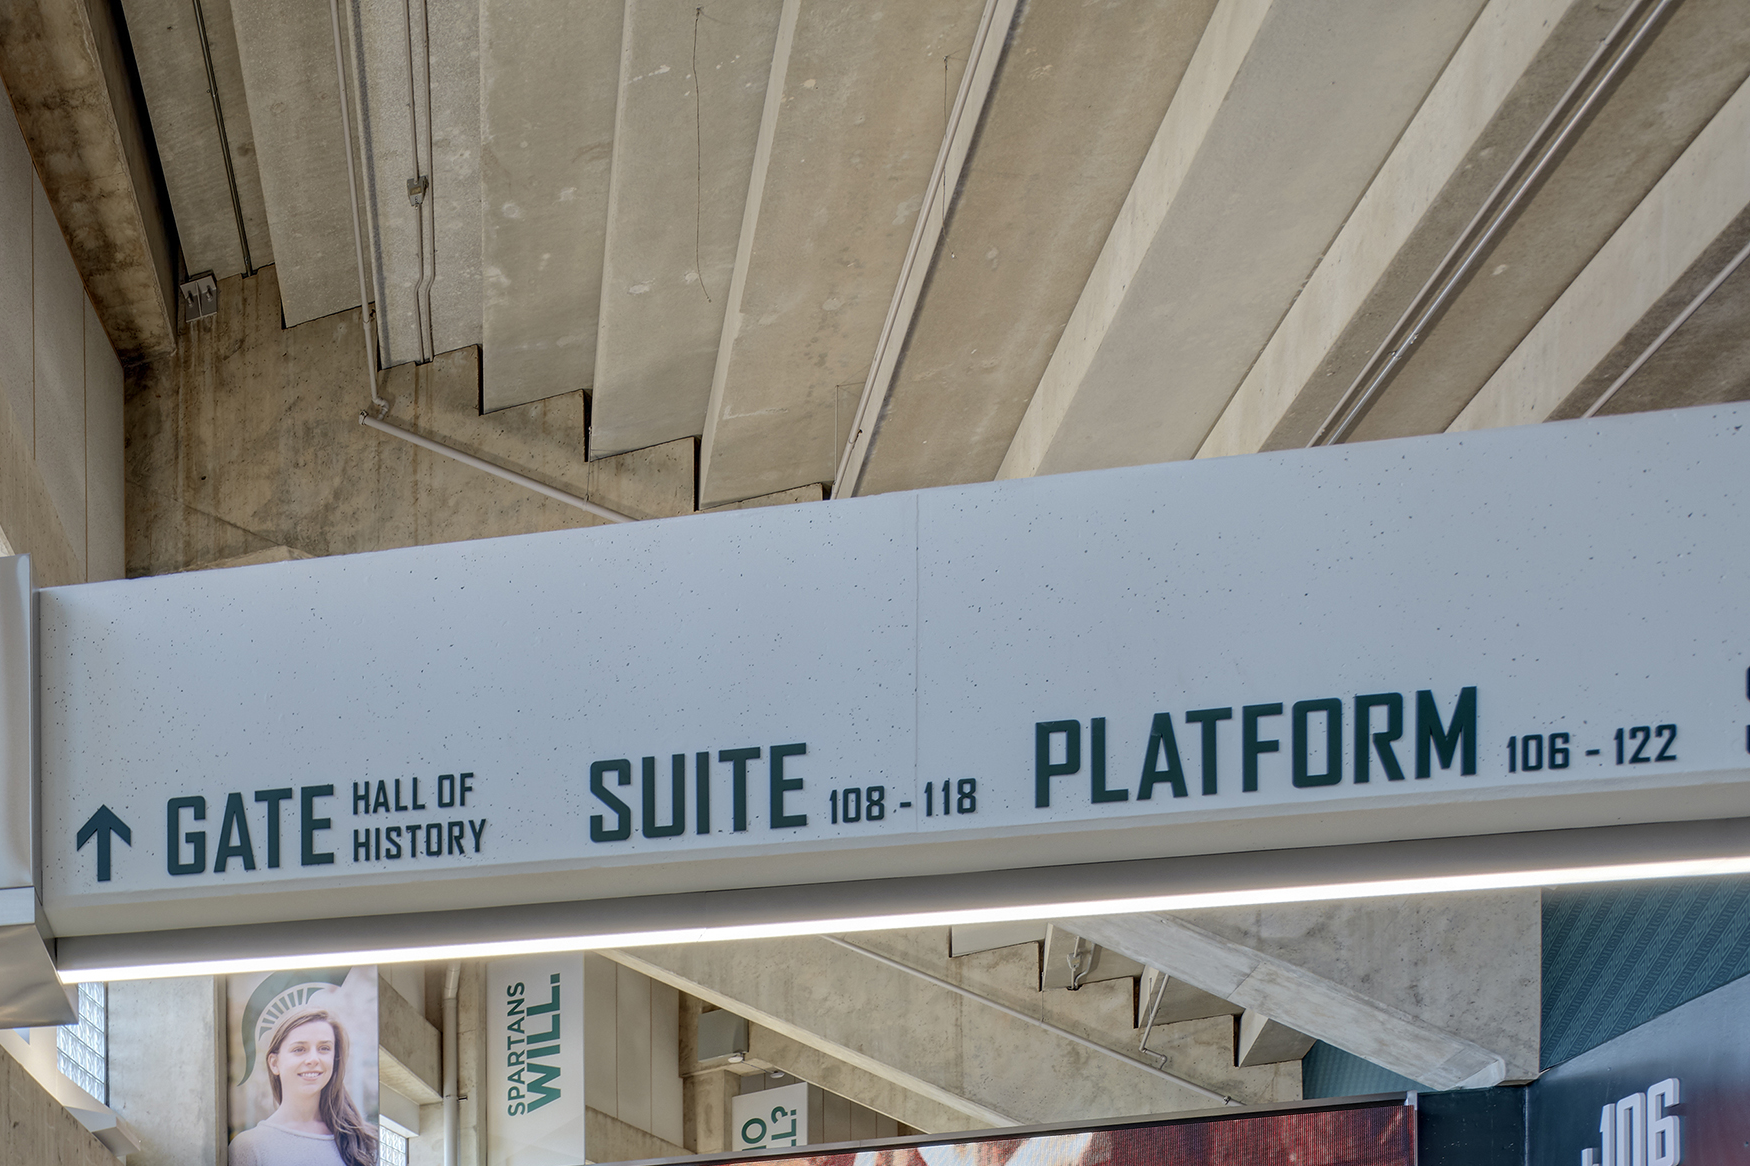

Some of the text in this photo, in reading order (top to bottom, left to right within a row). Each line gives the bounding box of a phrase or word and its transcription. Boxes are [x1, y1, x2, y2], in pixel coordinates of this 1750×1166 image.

[353, 772, 475, 815] HALL OF
[590, 743, 807, 843] SUITE
[829, 786, 885, 824] 108
[924, 778, 977, 817] 118
[1035, 686, 1478, 808] PLATFORM
[1506, 732, 1570, 773] 106
[1613, 724, 1678, 765] 122
[167, 784, 335, 876] GATE
[353, 819, 487, 862] HISTORY
[507, 981, 526, 1116] SPARTANS
[526, 973, 561, 1114] WILL.
